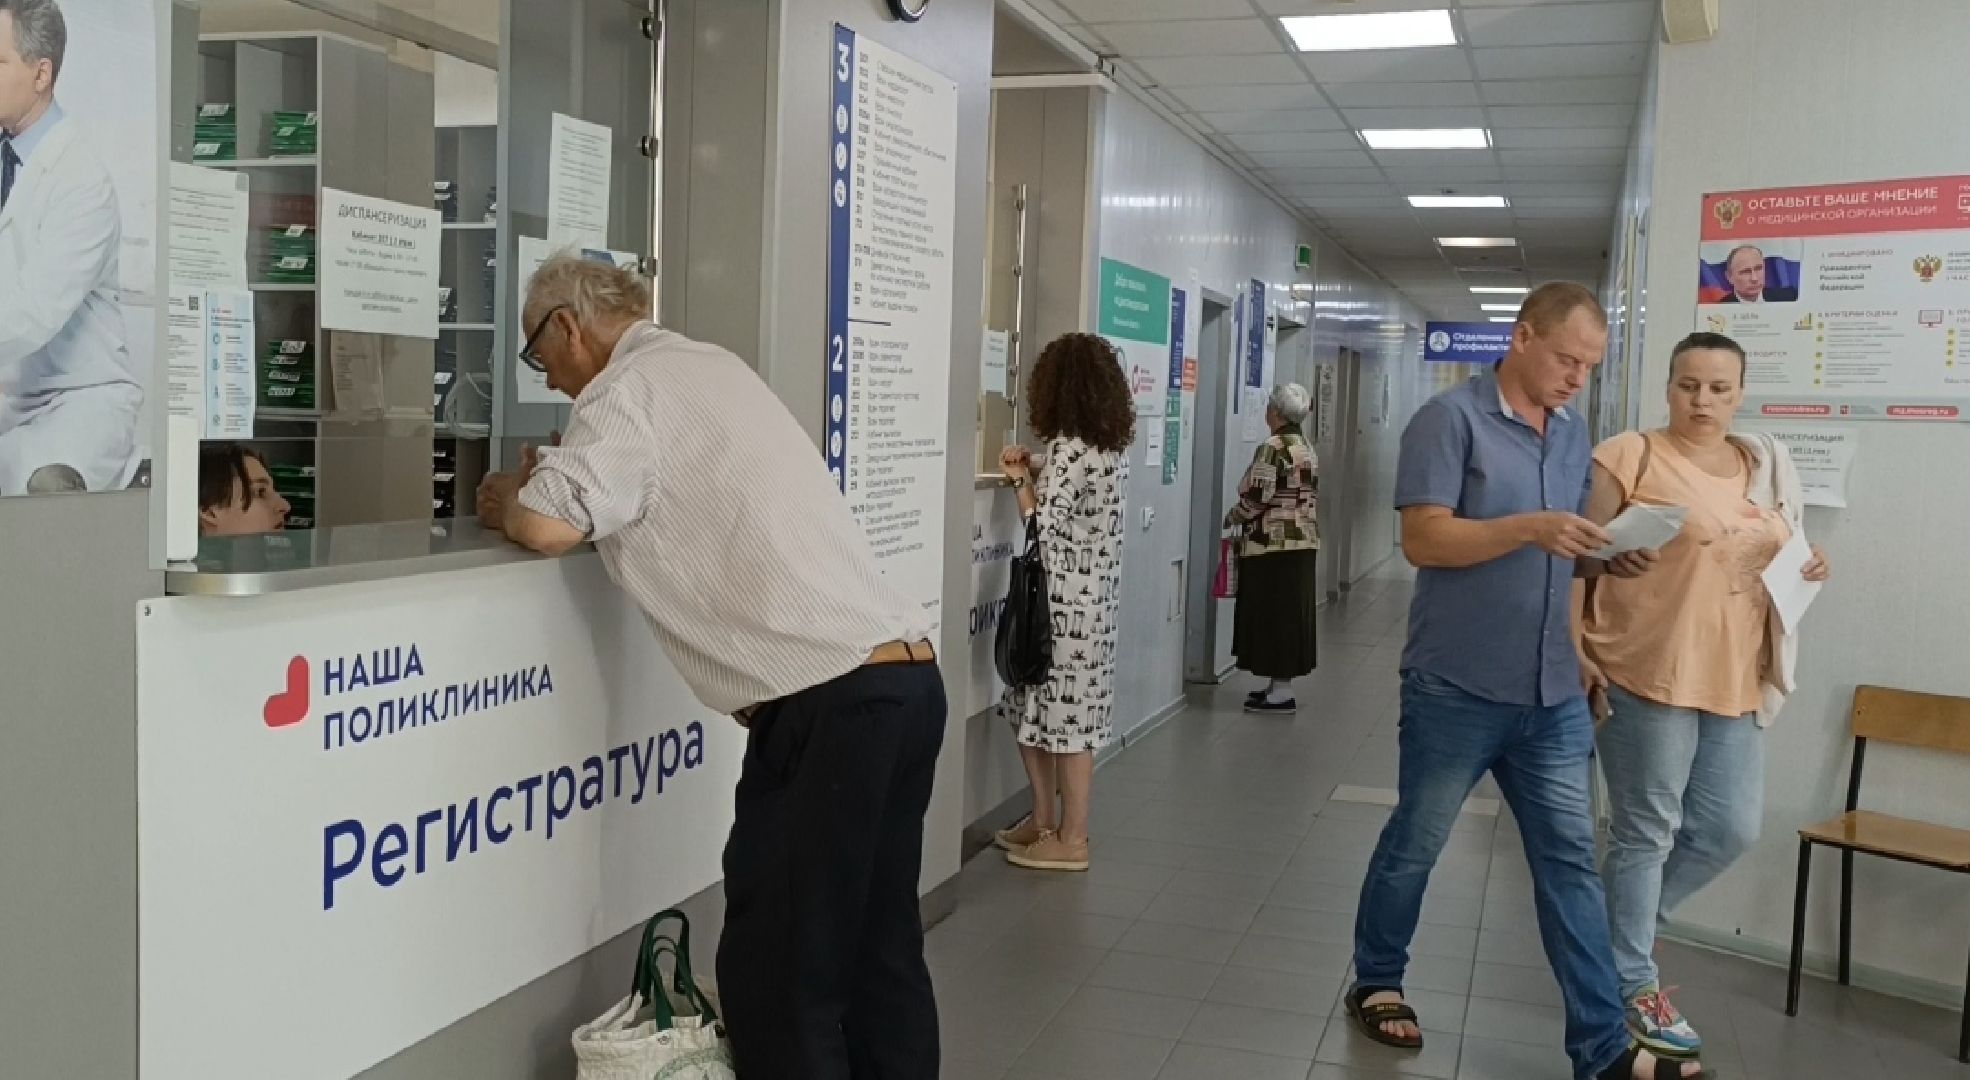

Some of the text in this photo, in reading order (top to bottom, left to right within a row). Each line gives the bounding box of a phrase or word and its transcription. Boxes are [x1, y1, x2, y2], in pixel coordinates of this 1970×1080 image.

[838, 42, 849, 83] 3
[1748, 186, 1939, 211] ОСТАВЬТЕ ВАШЕ МНЕНИЕ
[338, 204, 427, 229] ДИСПАНСЕРИЗАЦИЯ
[1747, 204, 1938, 226] О МЕДИЦИНСКОЙ ОРГАНИЗАЦИИ
[832, 335, 843, 373] 2
[1452, 343, 1512, 353] профилакти
[1773, 432, 1845, 443] ПАНСЕРИЗАЦИЯ
[324, 643, 424, 696] НАША
[324, 664, 553, 750] ПОЛИКЛИНИКА
[324, 720, 704, 911] Регистратура
